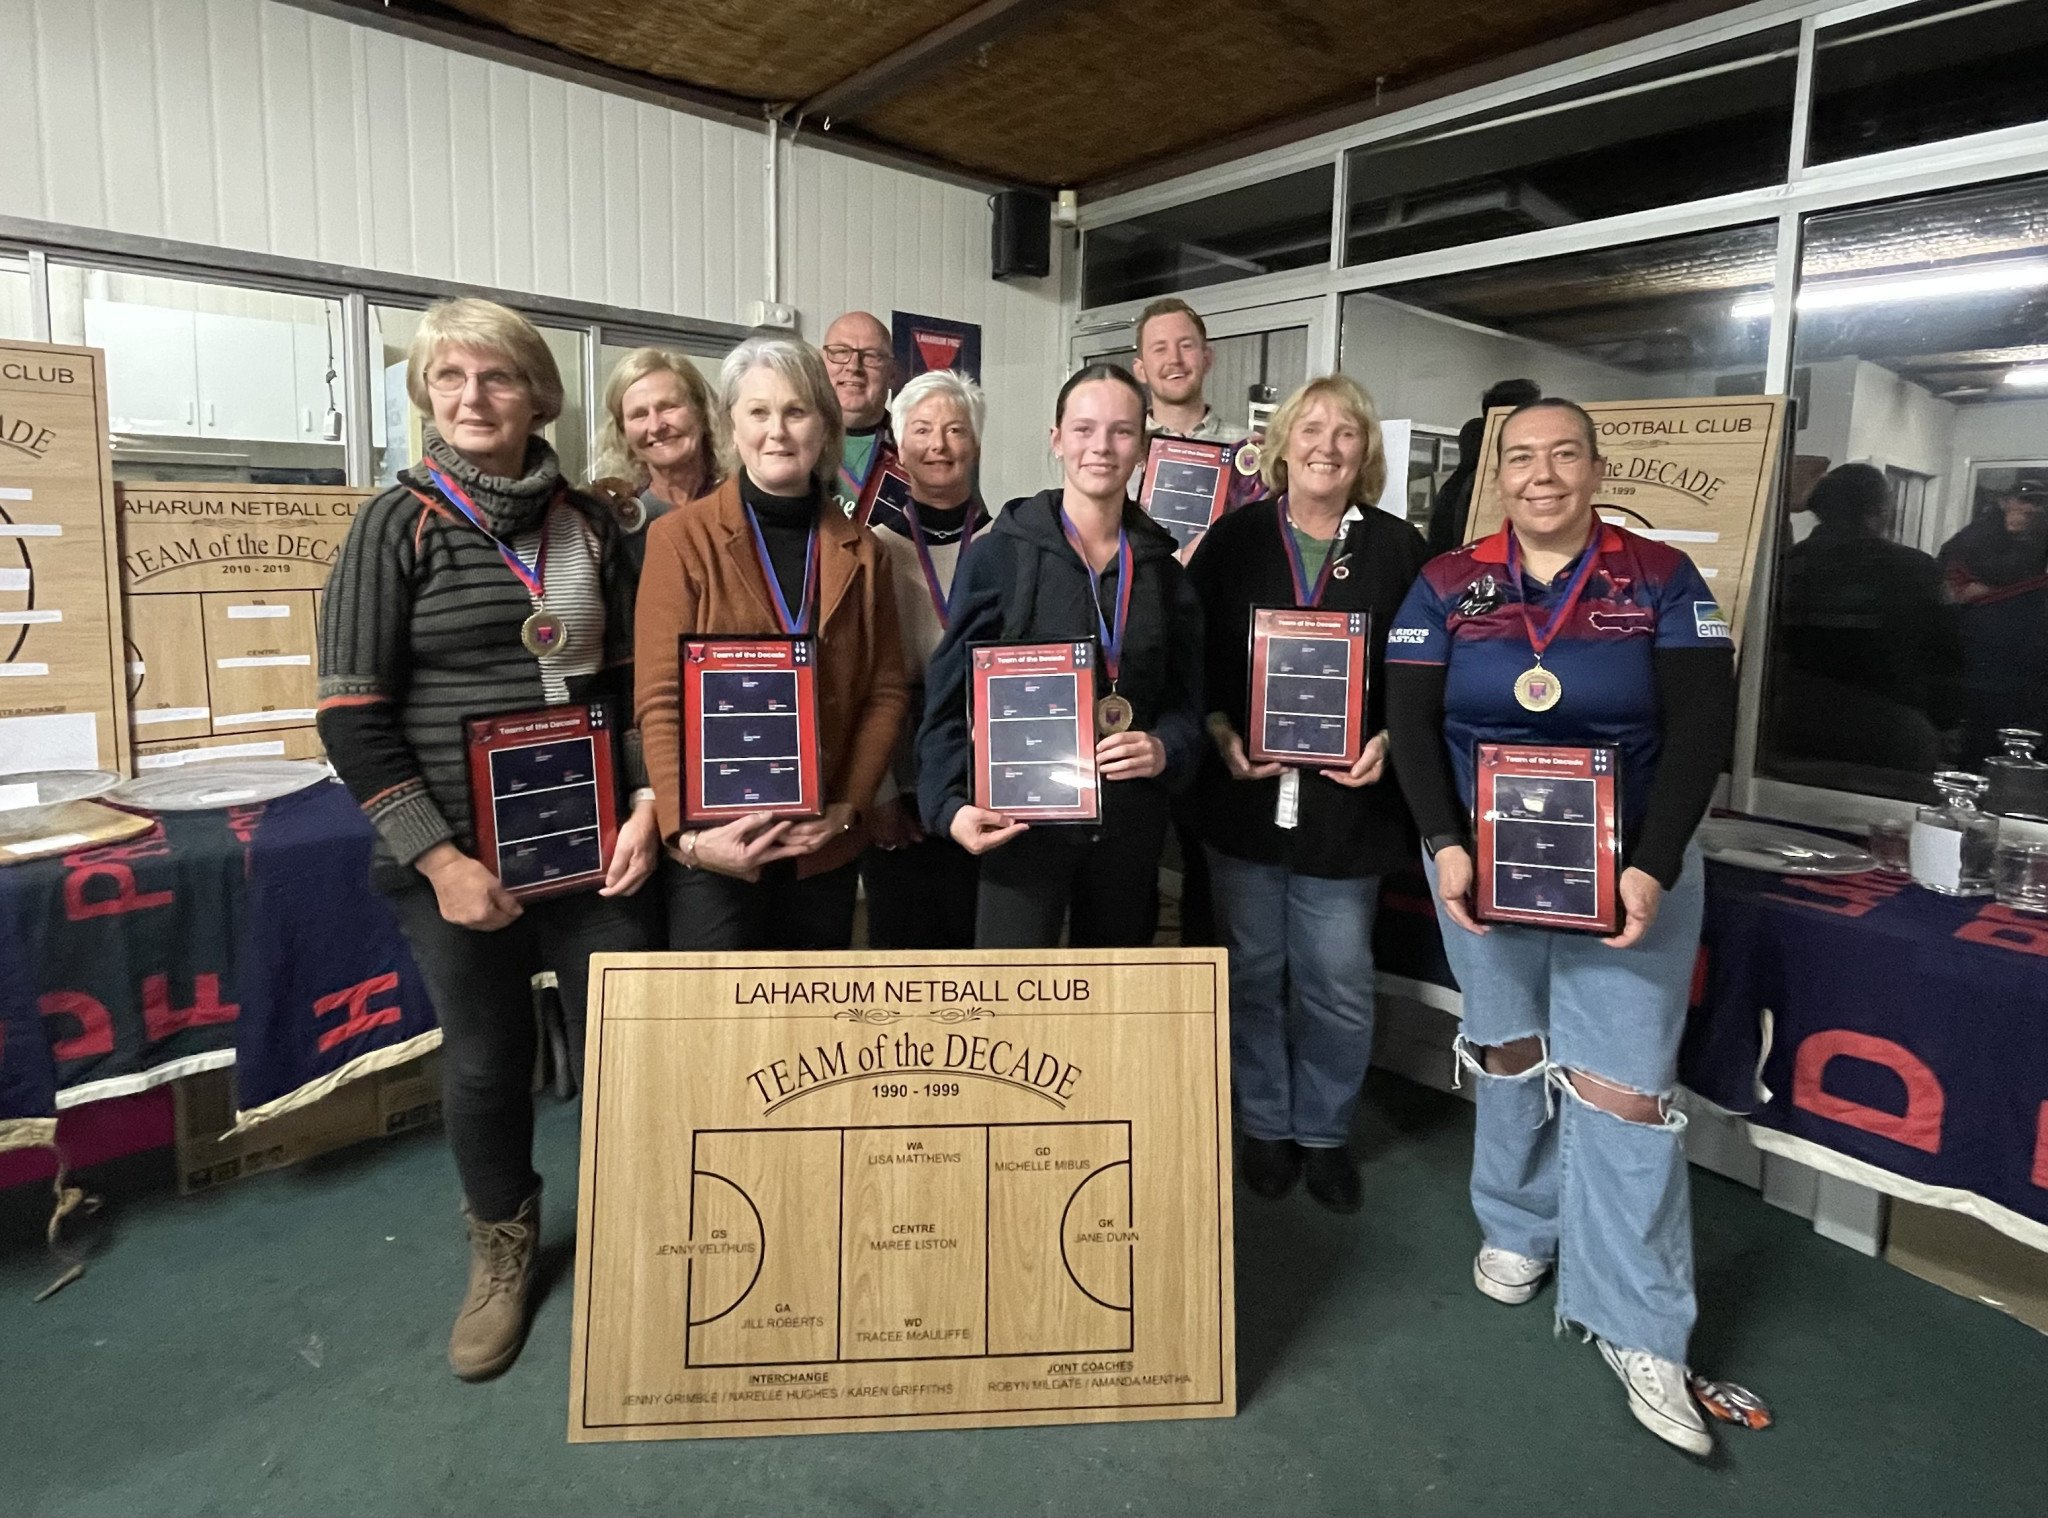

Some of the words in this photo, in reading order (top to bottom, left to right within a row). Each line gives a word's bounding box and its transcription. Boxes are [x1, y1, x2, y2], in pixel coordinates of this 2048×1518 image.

[2, 364, 75, 384] CLUB
[1696, 418, 1752, 433] CLUB
[1628, 457, 1726, 500] DECADE
[124, 499, 224, 515] AHARUM
[231, 501, 326, 517] NETBALL
[209, 534, 232, 557] of
[237, 533, 269, 556] the
[277, 534, 340, 562] DECA
[222, 565, 251, 574] 2010
[263, 564, 291, 573] 2019
[735, 981, 875, 1005] LAHARUM
[885, 980, 1009, 1003] NETBALL
[1017, 978, 1090, 1002] CLUB
[746, 1041, 850, 1104] TEAM
[858, 1033, 888, 1071] of
[894, 1033, 934, 1067] the
[944, 1033, 1082, 1101] DECADE
[871, 1084, 908, 1098] 1990
[926, 1083, 960, 1097] 1999
[906, 1142, 924, 1151] WA
[1035, 1147, 1051, 1156] GD
[868, 1154, 893, 1165] LISA
[896, 1153, 961, 1164] MATTHEWS
[995, 1161, 1050, 1171] MICHELLE
[1054, 1160, 1091, 1170] MIBUS
[892, 1224, 936, 1234] CENTRE
[1098, 1219, 1114, 1227] GK
[711, 1230, 727, 1239] GS
[1074, 1233, 1102, 1243] JANE
[1106, 1232, 1139, 1242] DUNN
[656, 1244, 696, 1256] JENNY
[699, 1243, 756, 1255] VELTHUIS
[870, 1240, 911, 1251] MAREE
[915, 1238, 957, 1249] LISTON
[775, 1304, 791, 1313] GA
[740, 1318, 764, 1329] JILL
[767, 1316, 824, 1328] ROBERTS
[904, 1318, 922, 1327] WD
[856, 1331, 902, 1342] TRACEE
[907, 1329, 970, 1341] McAULIFFE
[1048, 1363, 1078, 1374] JOINT
[1081, 1360, 1133, 1372] COACHES
[748, 1372, 829, 1384] INTERCHANGE
[988, 1379, 1029, 1391] ROBYN
[1091, 1376, 1141, 1388] AMANDA
[622, 1394, 662, 1406] JENNY
[729, 1390, 783, 1401] NARELLE
[786, 1387, 838, 1400] HUGHES
[847, 1385, 889, 1398] KAREN
[892, 1383, 954, 1396] GRIFFITHS
